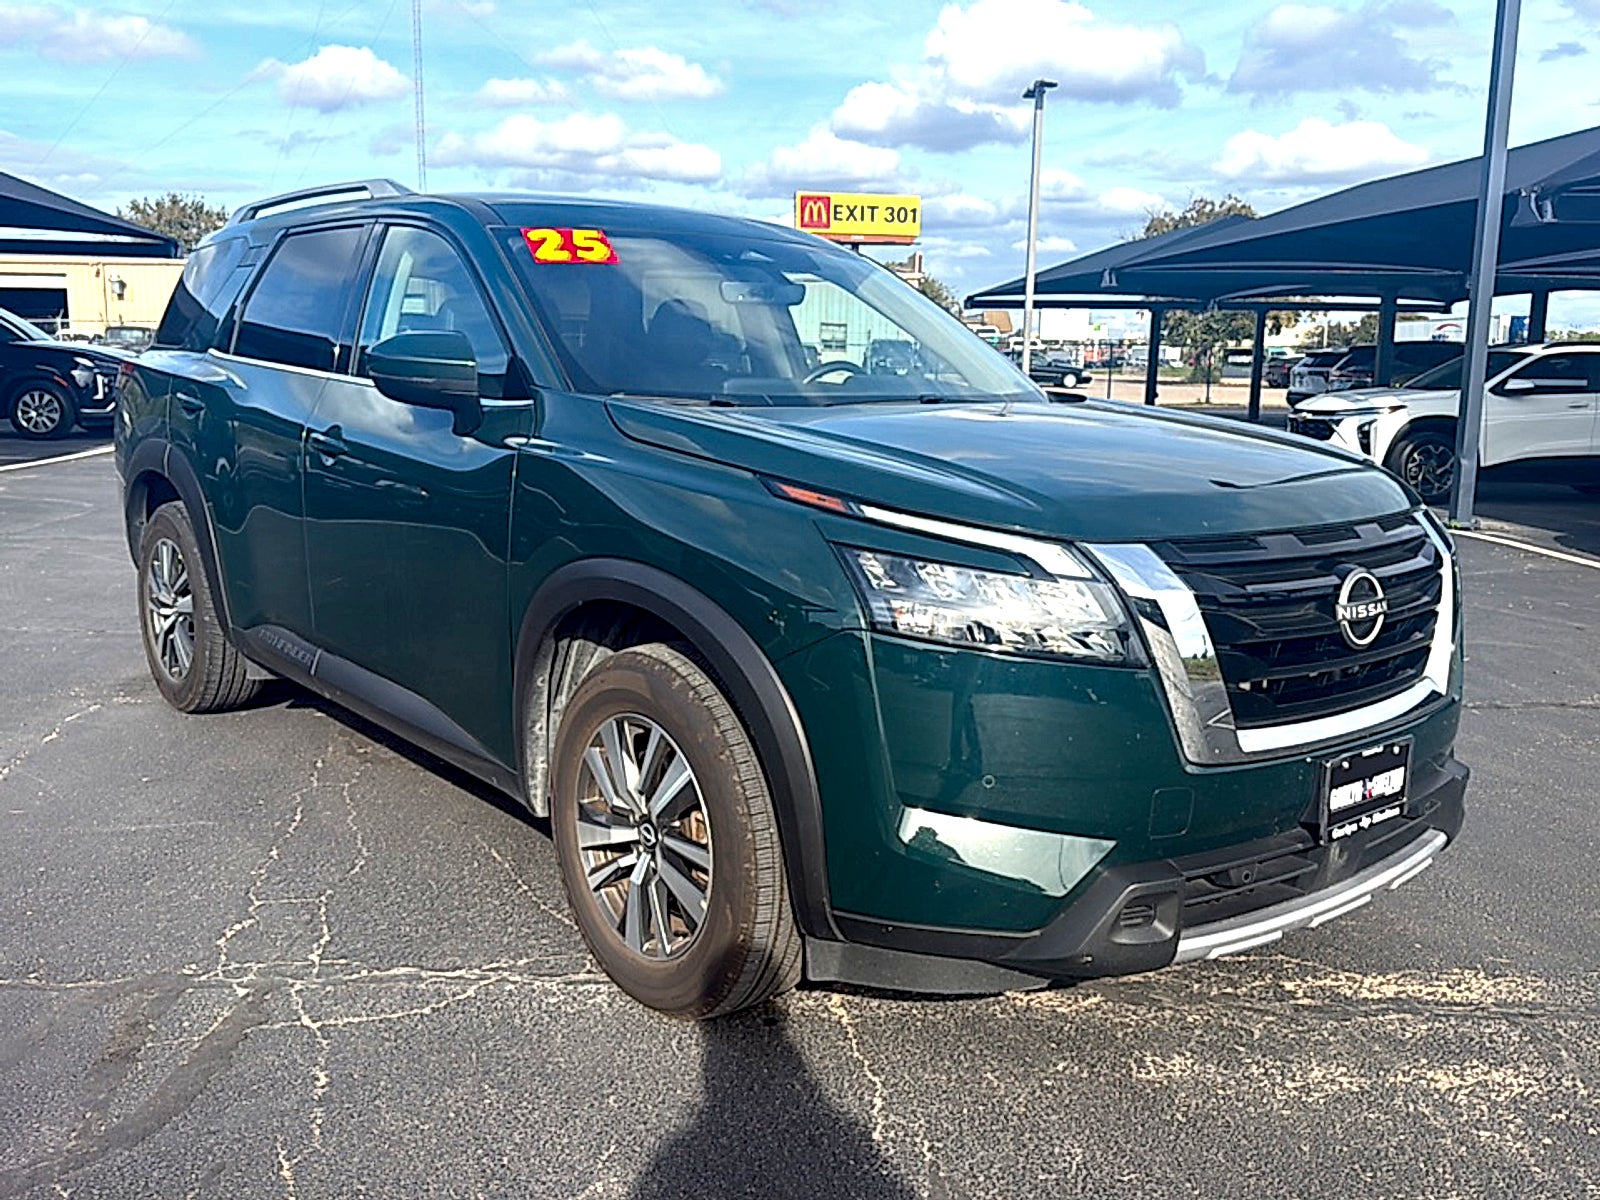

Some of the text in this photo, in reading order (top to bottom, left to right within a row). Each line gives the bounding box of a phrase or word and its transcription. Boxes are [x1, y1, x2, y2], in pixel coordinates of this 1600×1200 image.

[833, 204, 879, 222] EXIT
[884, 206, 917, 223] 301
[526, 228, 612, 261] 25
